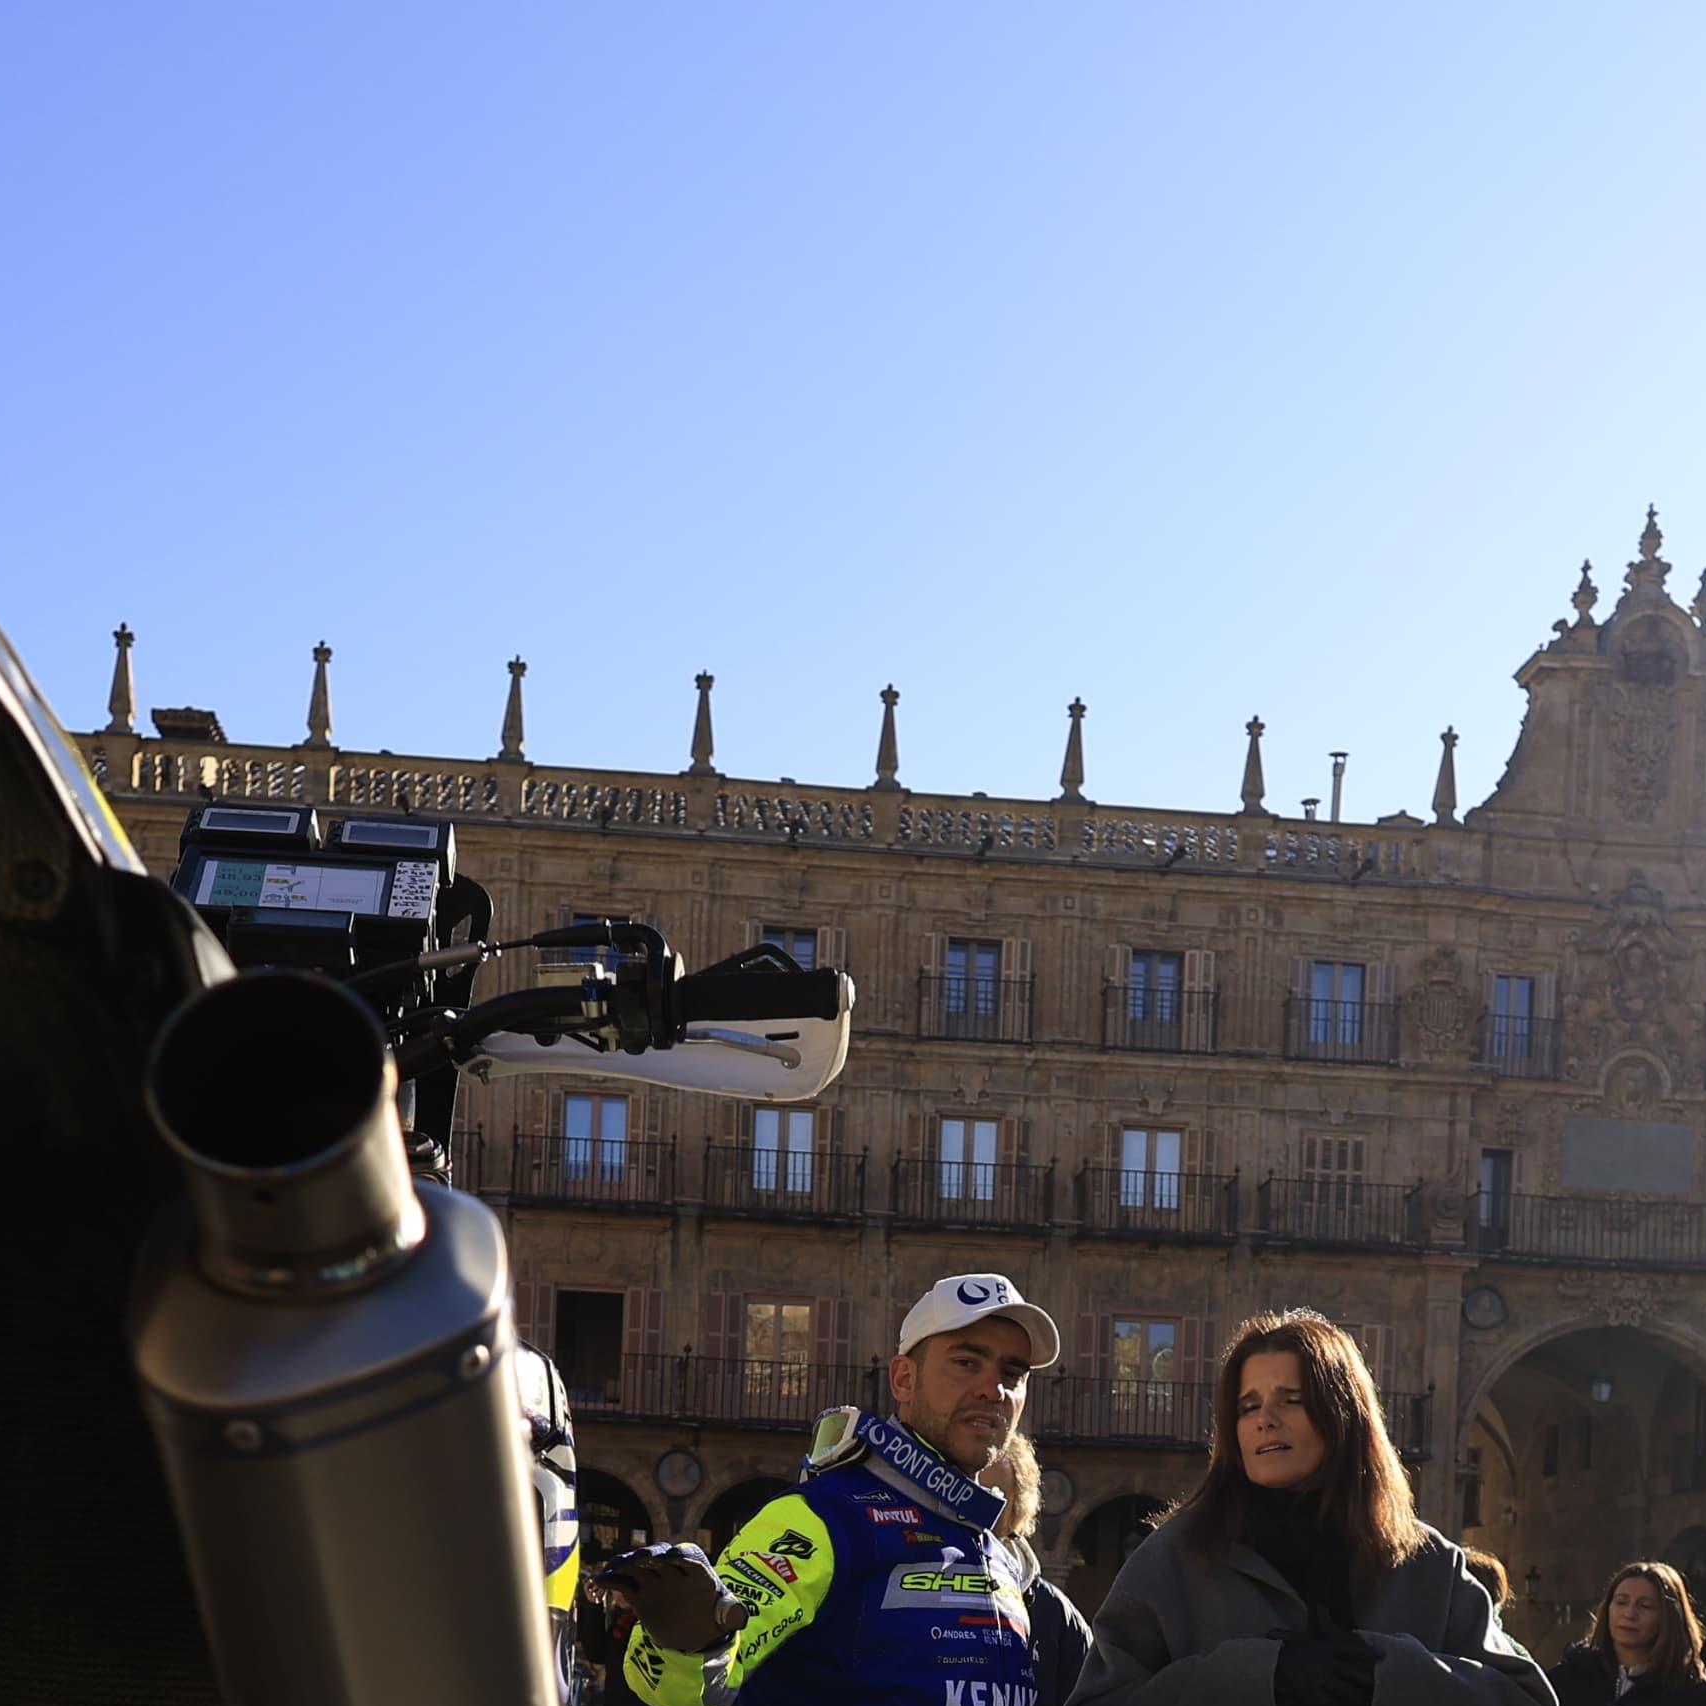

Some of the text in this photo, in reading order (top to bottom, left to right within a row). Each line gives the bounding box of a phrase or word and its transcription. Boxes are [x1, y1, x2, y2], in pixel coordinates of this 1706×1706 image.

[883, 1436, 975, 1507] PONT GRUP
[725, 1582, 763, 1602] AFAM
[734, 1559, 784, 1597] MICHELIN
